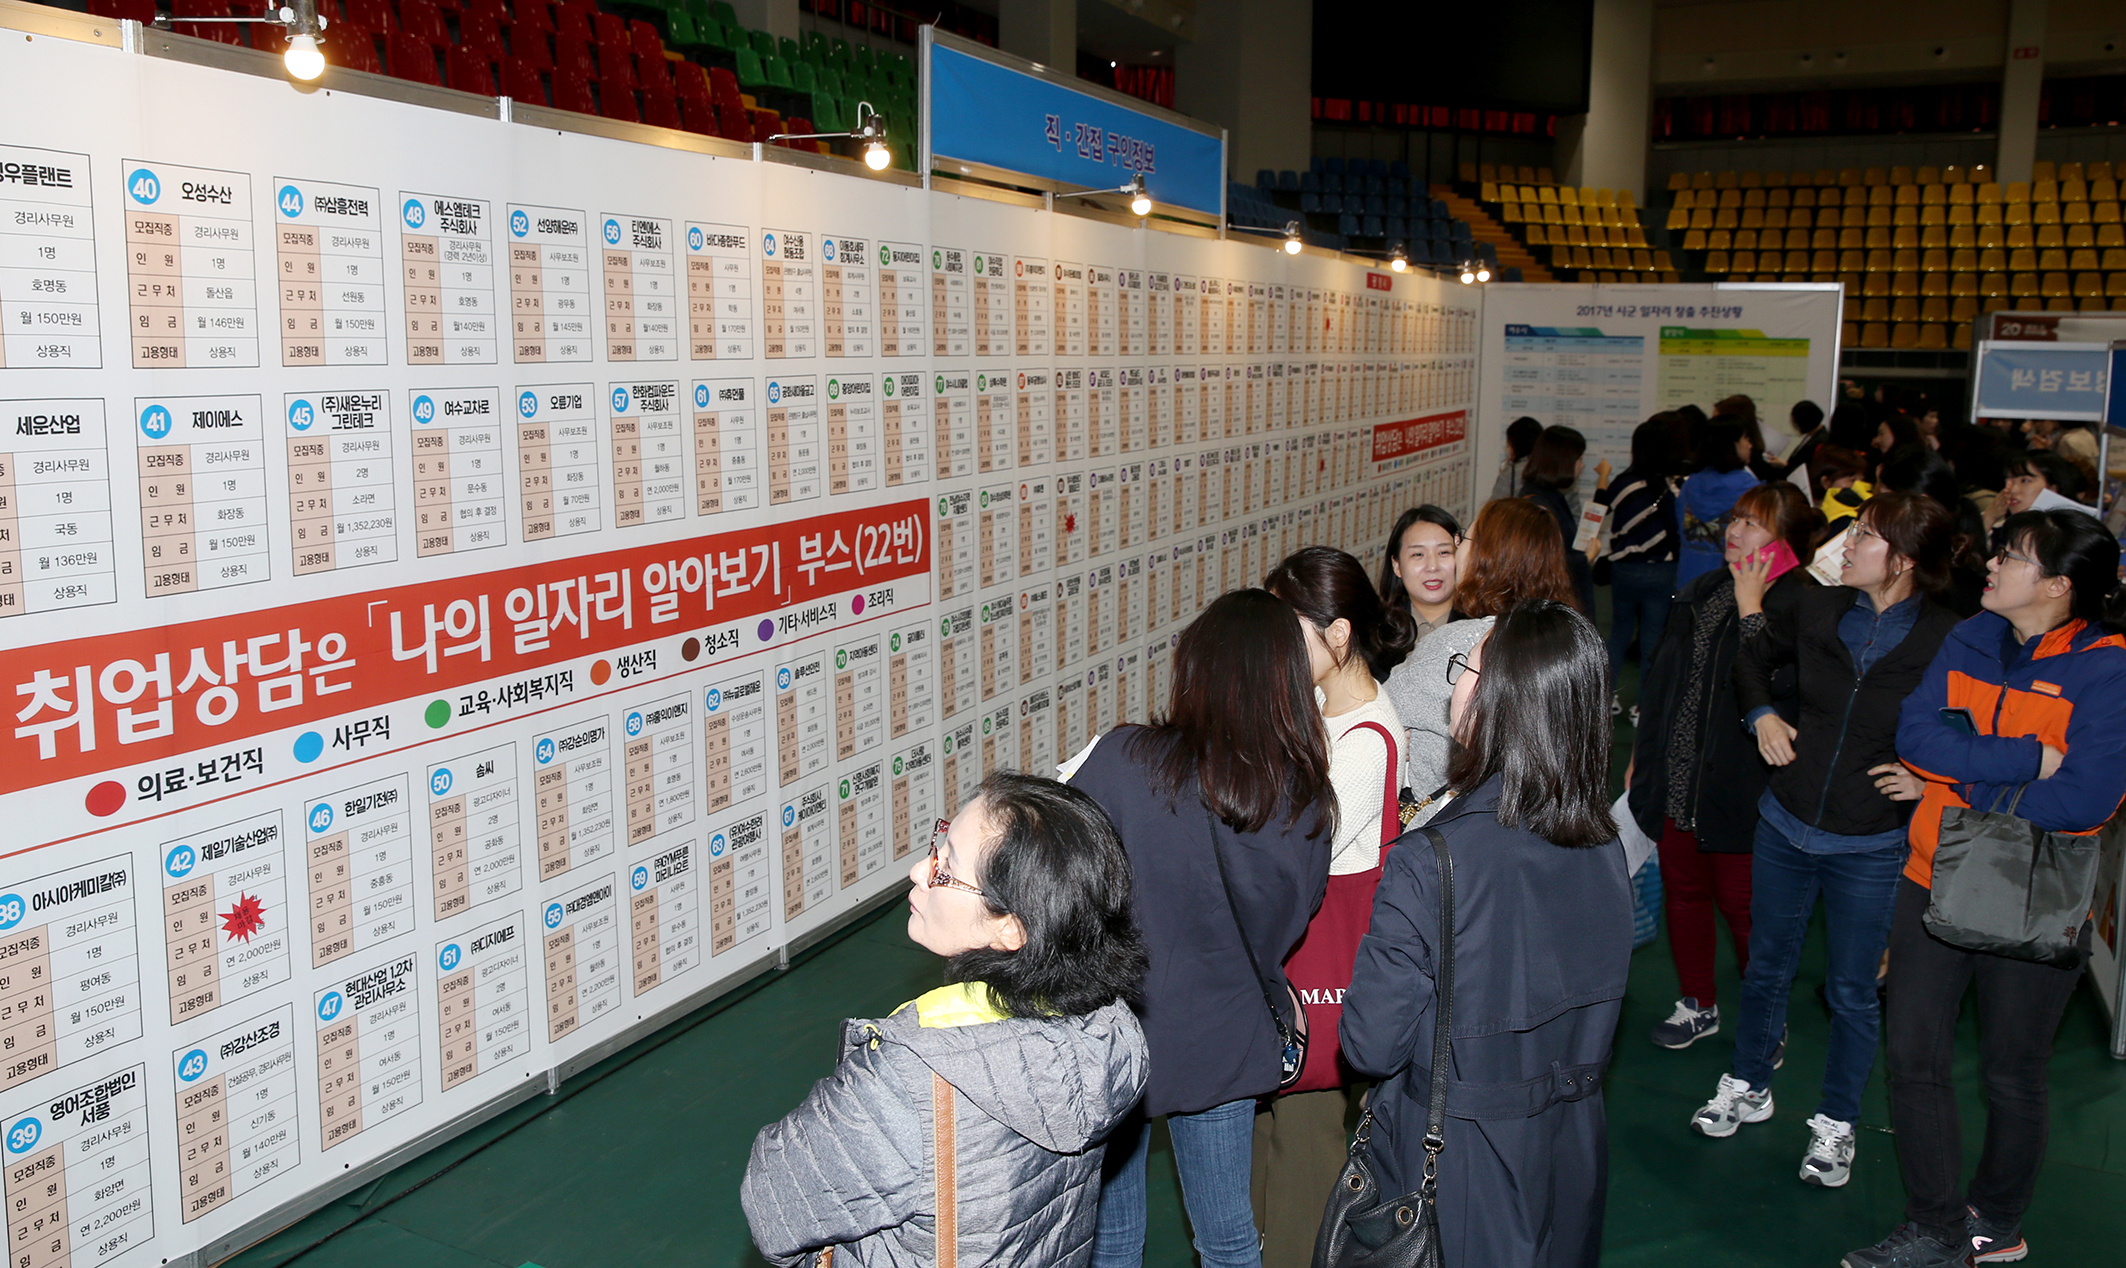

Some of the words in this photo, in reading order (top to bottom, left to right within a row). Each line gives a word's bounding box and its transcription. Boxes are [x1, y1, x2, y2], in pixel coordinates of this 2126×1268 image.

[1045, 113, 1062, 152] 직
[1075, 123, 1104, 163] 간접
[1107, 132, 1156, 174] 구인정보
[133, 178, 157, 199] 40
[182, 182, 232, 204] 오성수산
[281, 193, 301, 213] 44
[406, 206, 422, 224] 48
[434, 200, 482, 219] 에스엠테크
[14, 211, 74, 228] 경리사무원
[135, 221, 172, 236] 모집직종
[440, 217, 477, 235] 주식회사
[513, 216, 527, 232] 52
[195, 226, 239, 241] 경리사무원
[606, 225, 619, 240] 56
[633, 234, 662, 249] 주식회사
[690, 232, 701, 247] 60
[38, 247, 56, 260] 1명
[32, 279, 67, 293] 호명동
[206, 287, 233, 299] 돌산읍
[20, 311, 32, 325] 월
[37, 313, 82, 326] 150만원
[1577, 306, 1613, 317] 2017년
[1640, 306, 1671, 318] 일자리
[197, 316, 206, 328] 월
[210, 317, 244, 329] 146만원
[2001, 322, 2020, 335] 20
[141, 346, 178, 359] 고용형태
[209, 346, 236, 359] 상용직
[522, 397, 535, 413] 53
[614, 393, 626, 408] 57
[632, 384, 675, 399] 한화컴파운드
[292, 407, 311, 425] 45
[321, 395, 382, 413] (주)새온누리
[416, 402, 432, 419] 49
[444, 400, 490, 416] 여수교차로
[641, 399, 669, 412] 주식회사
[16, 415, 80, 436] 세운산업
[146, 412, 165, 432] 41
[192, 410, 243, 429] 제이에스
[332, 413, 374, 430] 그린테크
[33, 459, 89, 474] 경리사무원
[217, 507, 244, 520] 화장동
[55, 523, 78, 536] 국동
[347, 517, 392, 532] 1,352,230원
[39, 557, 50, 570] 월
[55, 552, 97, 567] 136만원
[154, 572, 190, 587] 고용형태
[15, 629, 356, 760] 취업상담은
[504, 569, 632, 655] 일자리
[797, 513, 924, 577] 부스(22번)
[137, 747, 264, 802] 의료·보건직
[332, 715, 391, 752] 사무직
[458, 670, 573, 717] 교육·사회복지직
[616, 650, 657, 681] 생산직
[705, 628, 740, 655] 청소직
[778, 602, 838, 635] 기타·서비스직
[868, 588, 894, 608] 조리직
[628, 717, 641, 732] 58
[539, 744, 553, 760] 54
[434, 774, 450, 792] 50
[476, 760, 494, 778] 솜씨
[312, 809, 330, 828] 46
[170, 851, 192, 872] 42
[228, 864, 271, 886] 경리사무원
[634, 871, 646, 887] 59
[0, 900, 20, 921] 38
[548, 908, 561, 925] 55
[66, 911, 118, 938] 경리사무원
[86, 945, 102, 959] 1명
[443, 948, 456, 966] 51
[321, 996, 339, 1016] 47
[345, 970, 387, 998] 현대산업
[354, 979, 406, 1010] 관리사무소
[70, 1011, 81, 1024] 월
[85, 995, 125, 1018] 150만원
[182, 1055, 204, 1076] 43
[12, 1124, 37, 1149] 39
[50, 1072, 136, 1121] 영어조합법인
[80, 1100, 110, 1126] 서풍
[250, 1110, 276, 1129] 신기동
[81, 1121, 131, 1152] 경리사무원
[94, 1179, 124, 1201] 화양면
[94, 1198, 141, 1230] 2,200만원
[98, 1232, 127, 1256] 상용직
